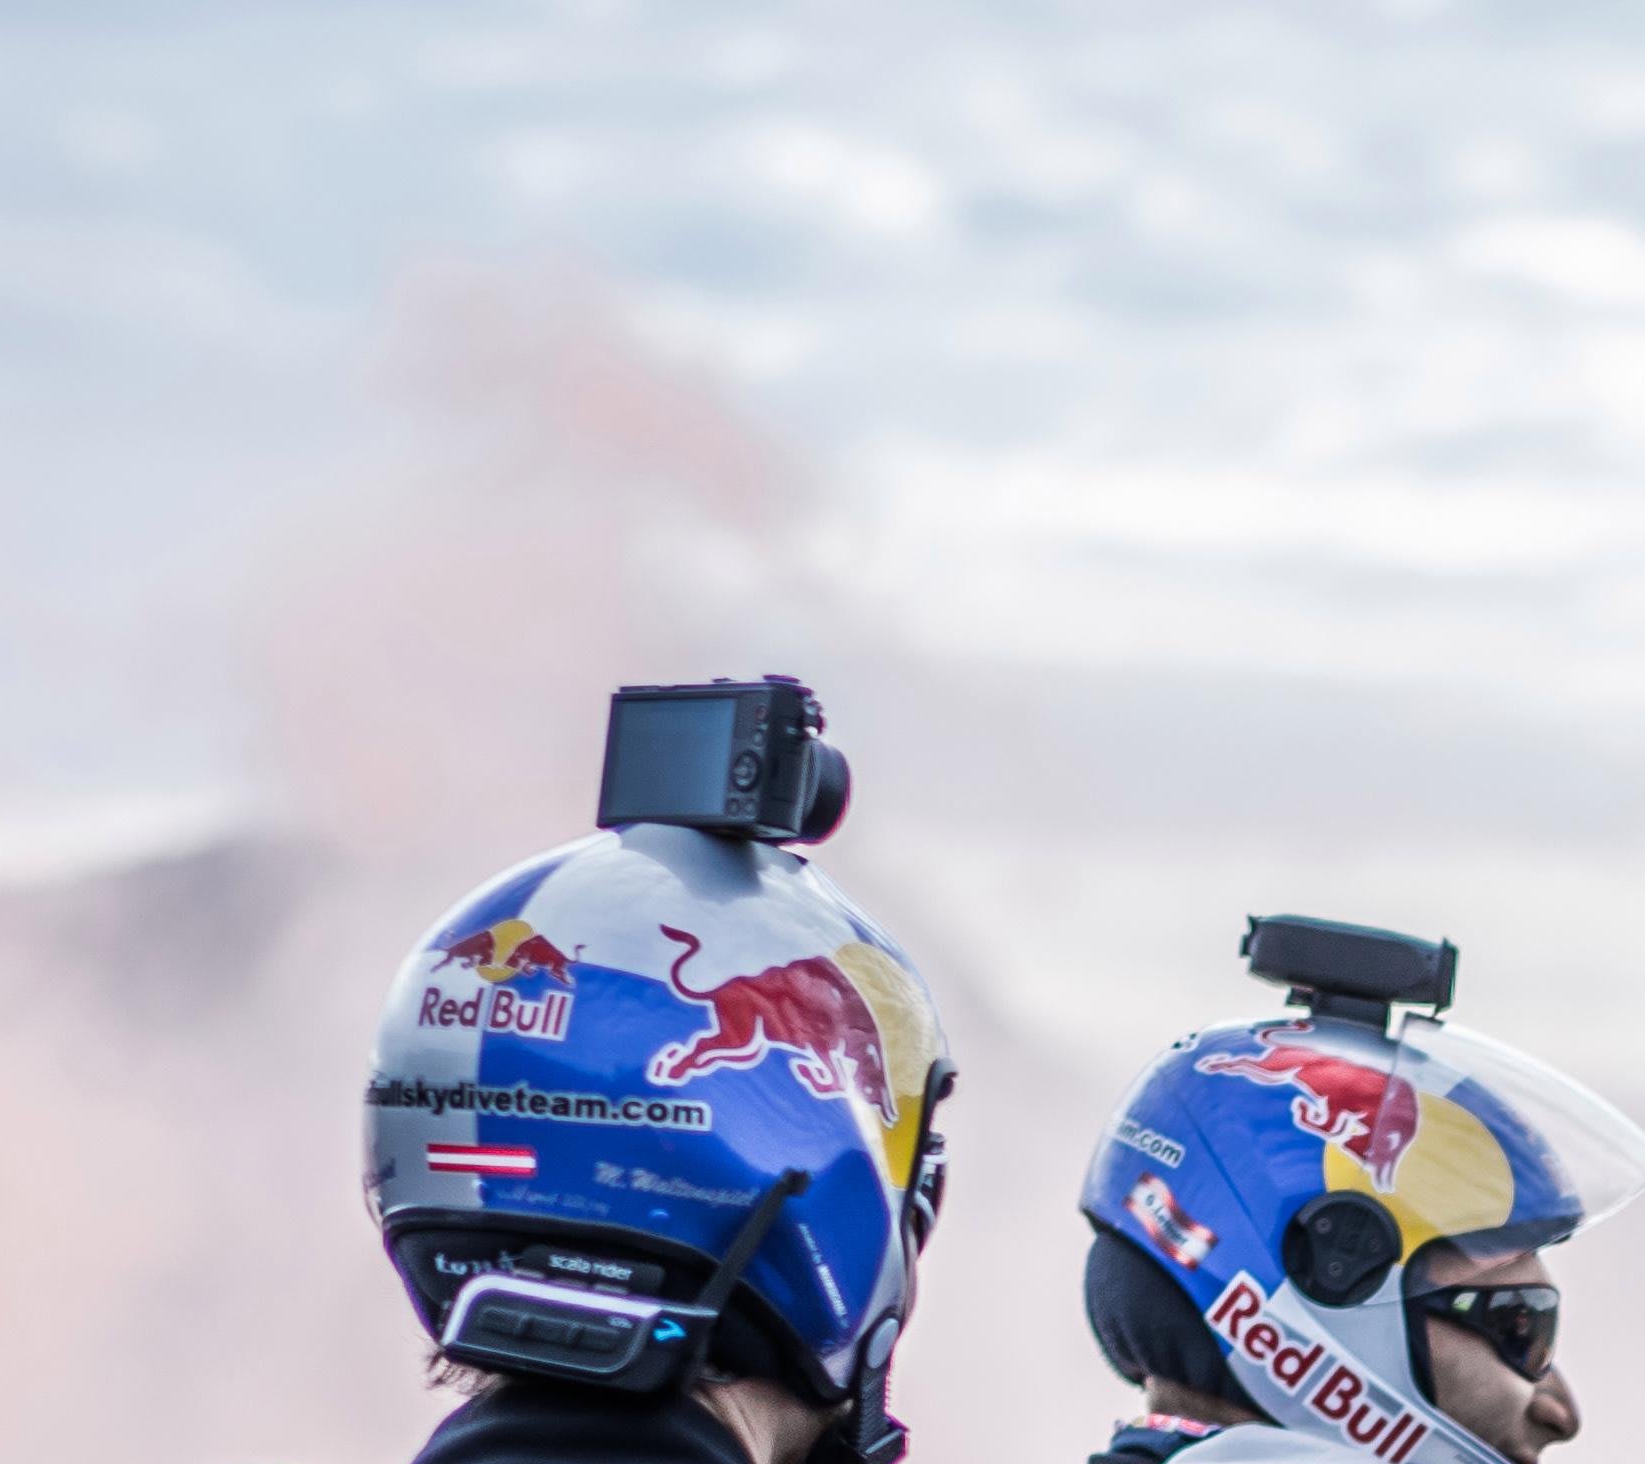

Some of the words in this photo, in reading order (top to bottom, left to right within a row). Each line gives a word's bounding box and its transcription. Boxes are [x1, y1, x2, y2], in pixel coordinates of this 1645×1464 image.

[418, 986, 484, 1028] Red
[489, 989, 568, 1037] Bull
[548, 1253, 592, 1274] scala
[1211, 1281, 1325, 1389] Red
